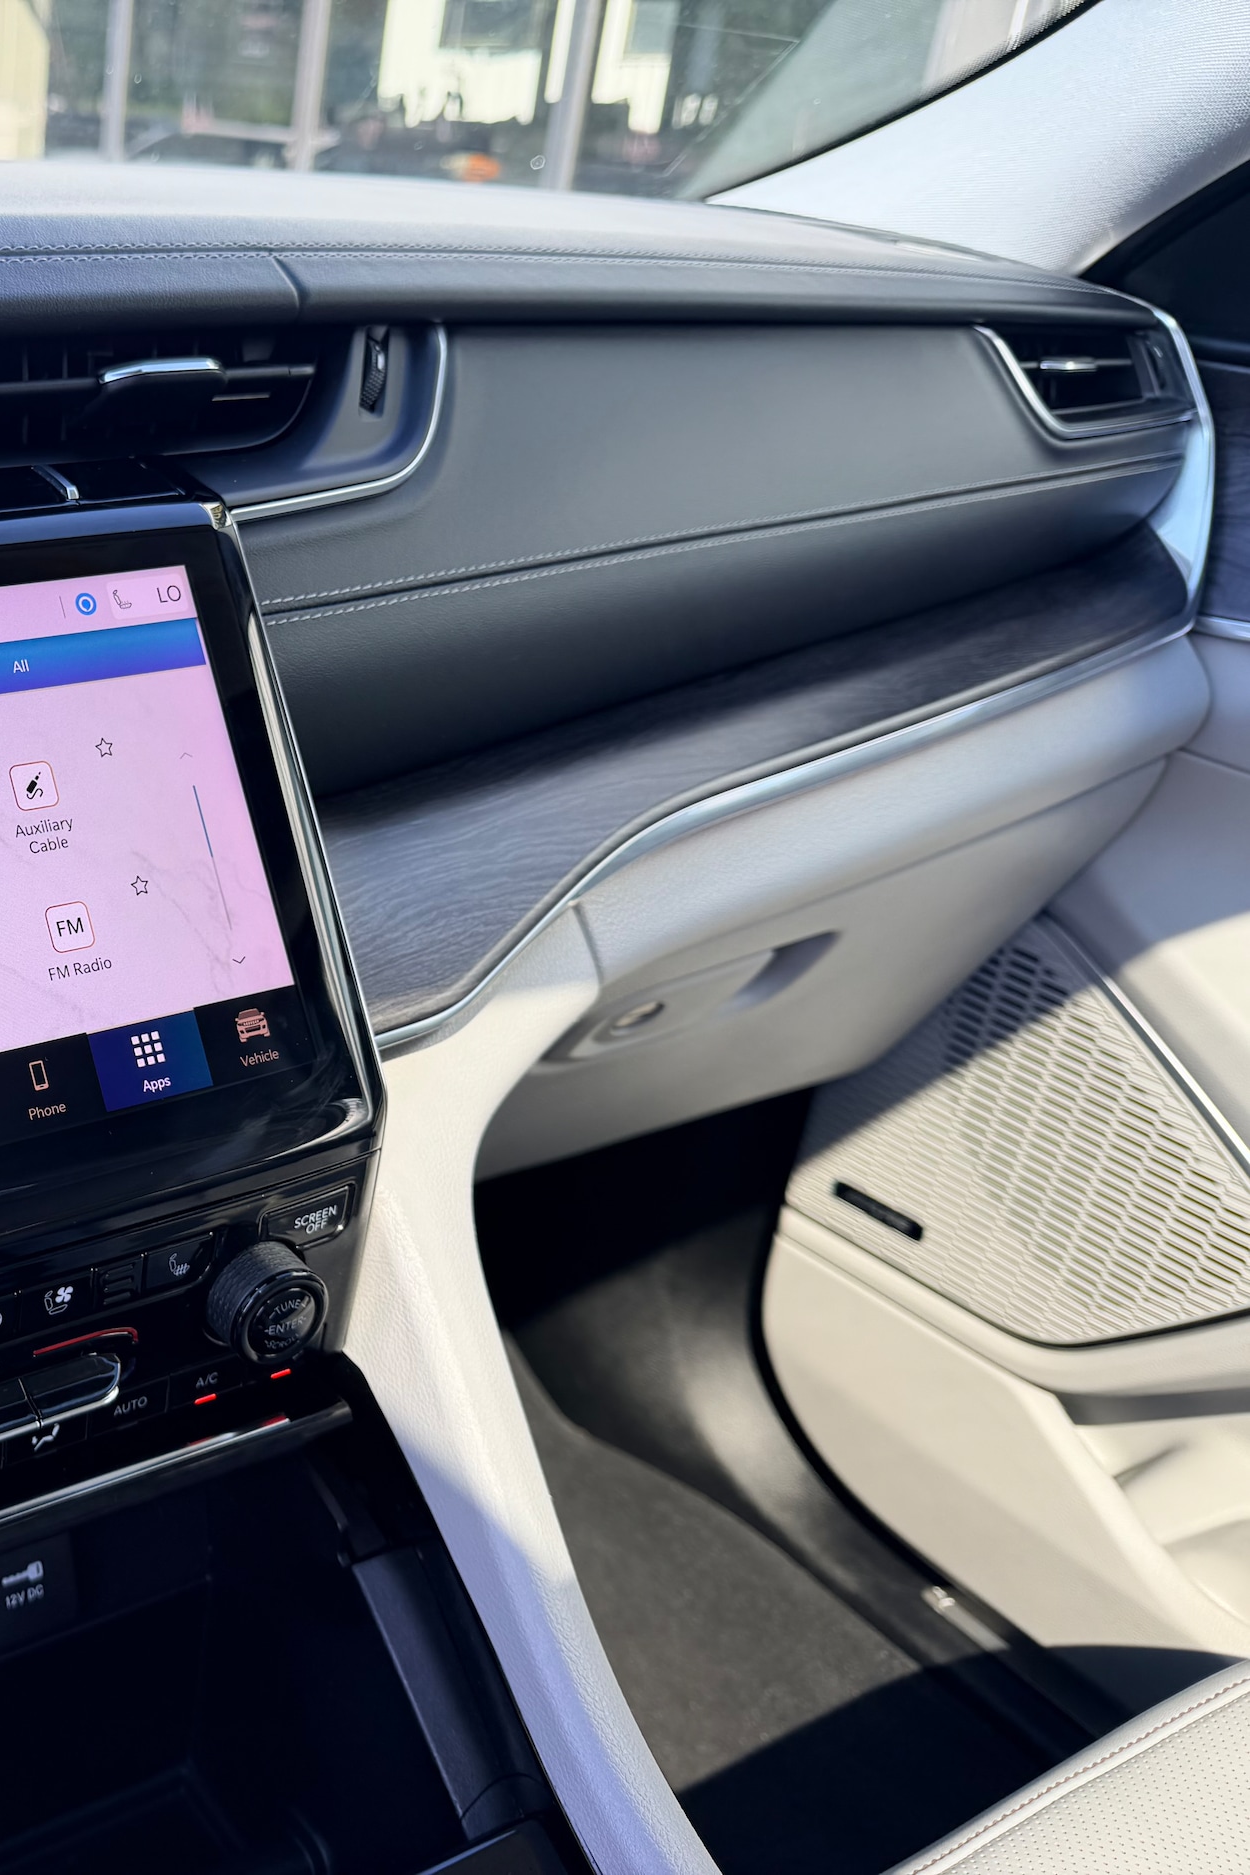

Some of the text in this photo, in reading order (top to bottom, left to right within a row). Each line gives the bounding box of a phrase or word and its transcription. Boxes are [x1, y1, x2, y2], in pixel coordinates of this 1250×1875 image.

[157, 585, 182, 603] LO
[12, 659, 30, 674] All
[15, 816, 74, 838] Auxiliary
[29, 836, 69, 854] Cable
[56, 917, 84, 937] FM
[48, 956, 112, 981] FM Radio
[240, 1048, 279, 1067] Vehicle
[143, 1075, 171, 1093] Apps
[28, 1102, 66, 1120] Phone
[294, 1205, 337, 1229] SCREEN
[305, 1218, 328, 1234] OFF
[196, 1372, 218, 1389] A/C
[114, 1396, 148, 1416] AUTO
[5, 1584, 44, 1609] 12V DC
